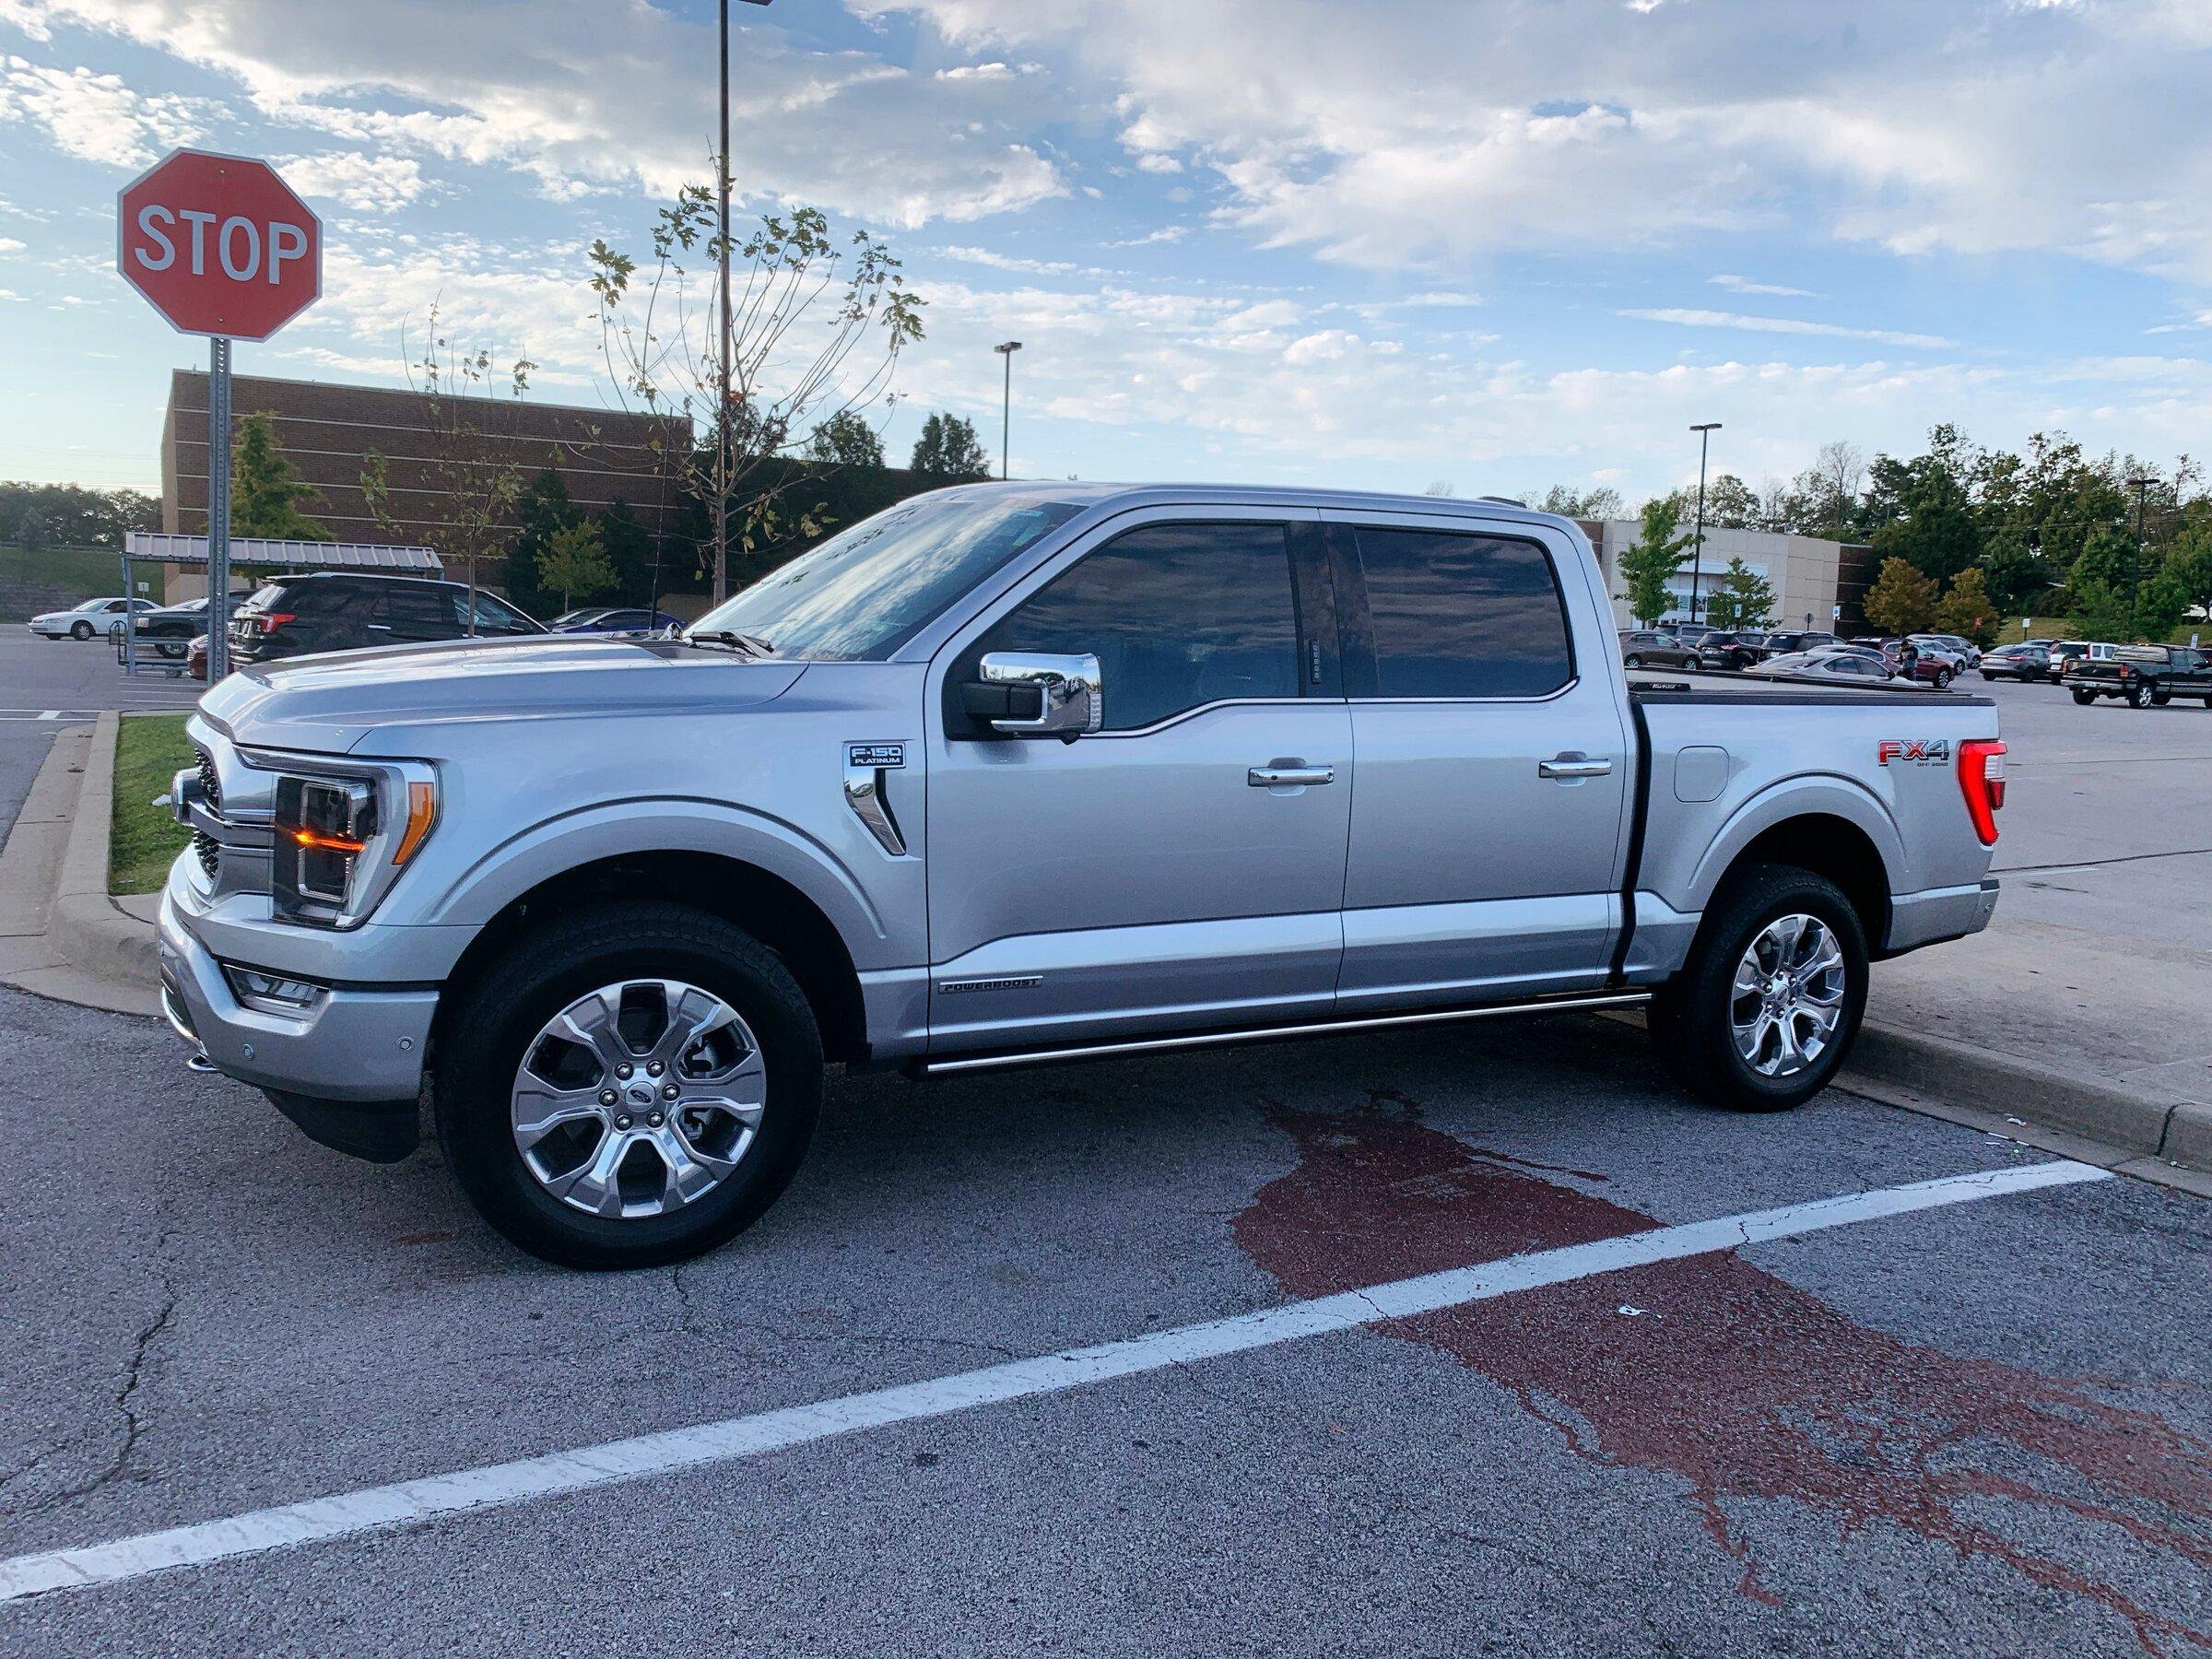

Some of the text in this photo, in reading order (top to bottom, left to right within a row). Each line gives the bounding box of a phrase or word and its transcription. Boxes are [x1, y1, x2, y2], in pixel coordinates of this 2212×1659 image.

[135, 205, 308, 285] STOP
[851, 747, 902, 758] F-150
[1877, 739, 1950, 767] FX4
[944, 978, 1040, 992] POWERBOOST
